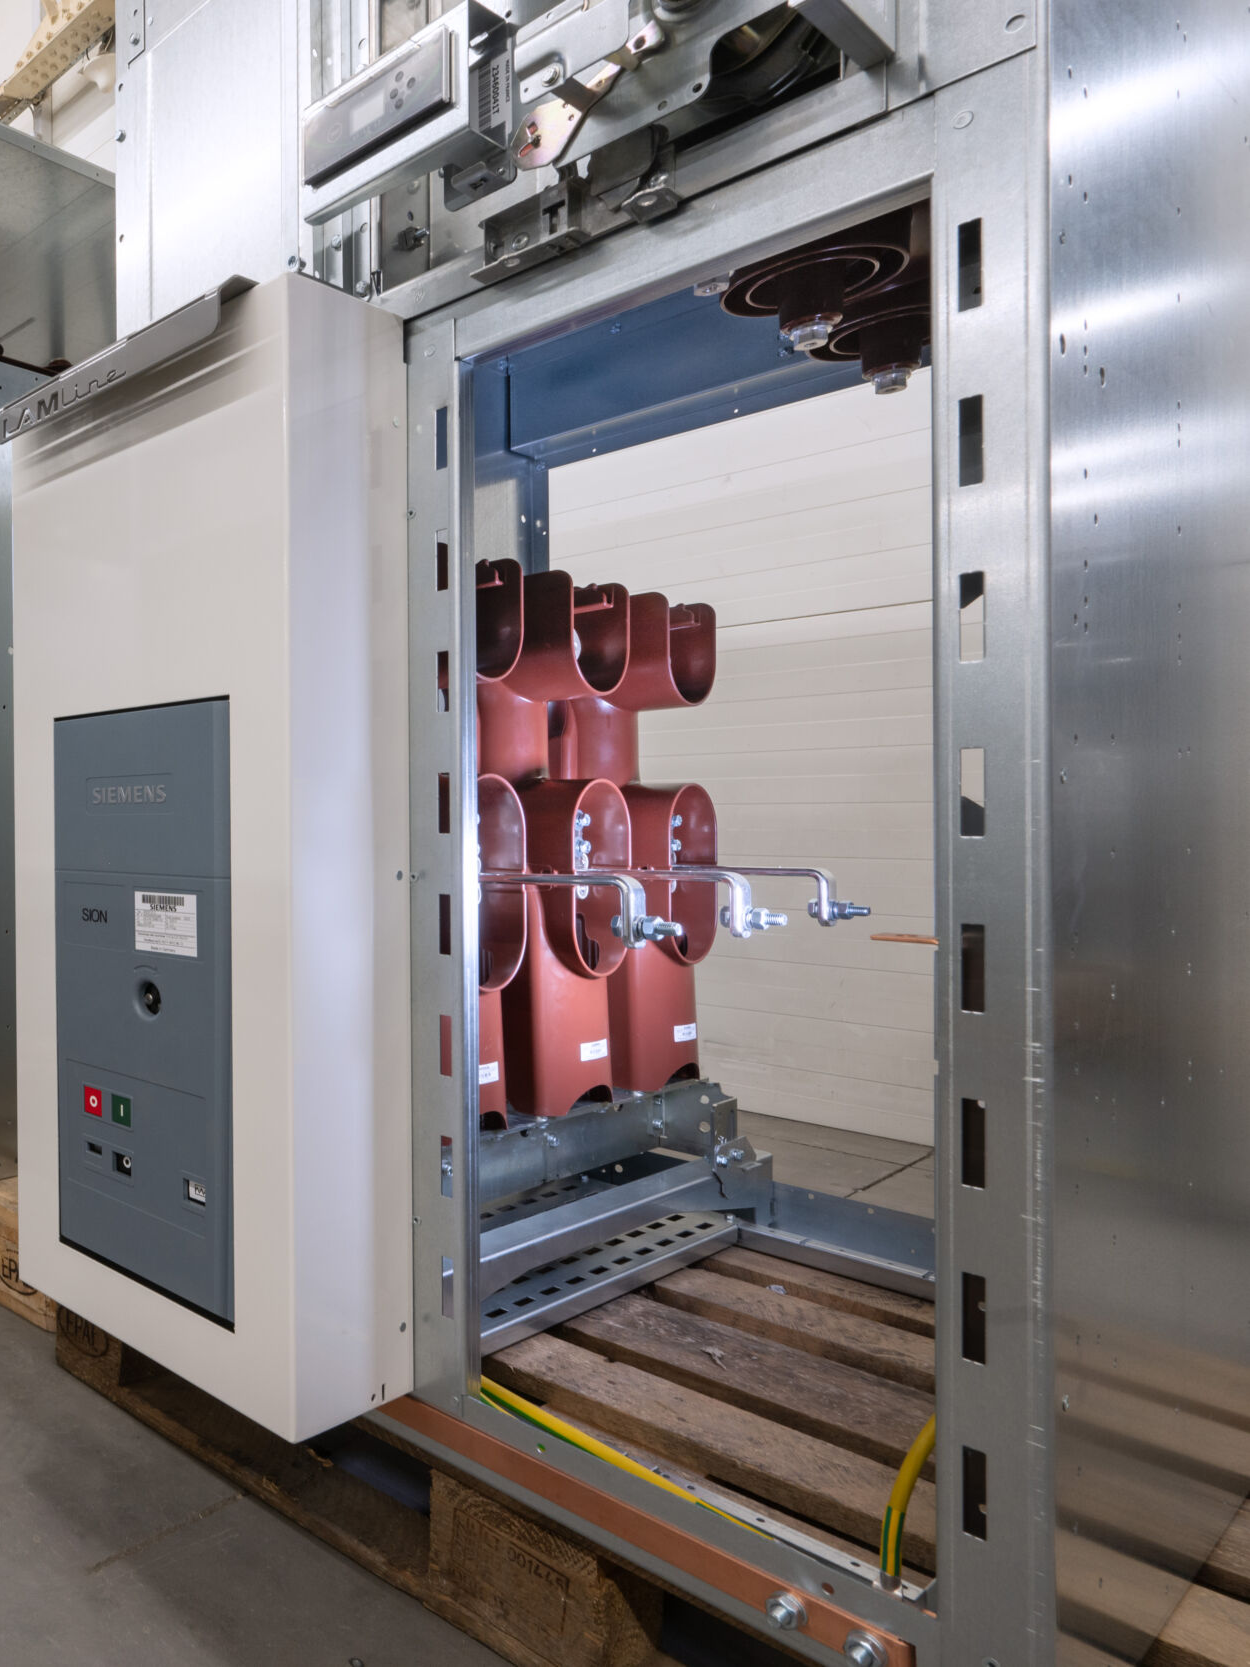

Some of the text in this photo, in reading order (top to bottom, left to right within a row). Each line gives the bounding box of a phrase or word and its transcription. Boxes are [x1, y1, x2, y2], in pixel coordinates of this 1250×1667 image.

[91, 783, 167, 805] SIEMENS
[81, 908, 108, 924] SION
[150, 904, 177, 912] SIEMENS
